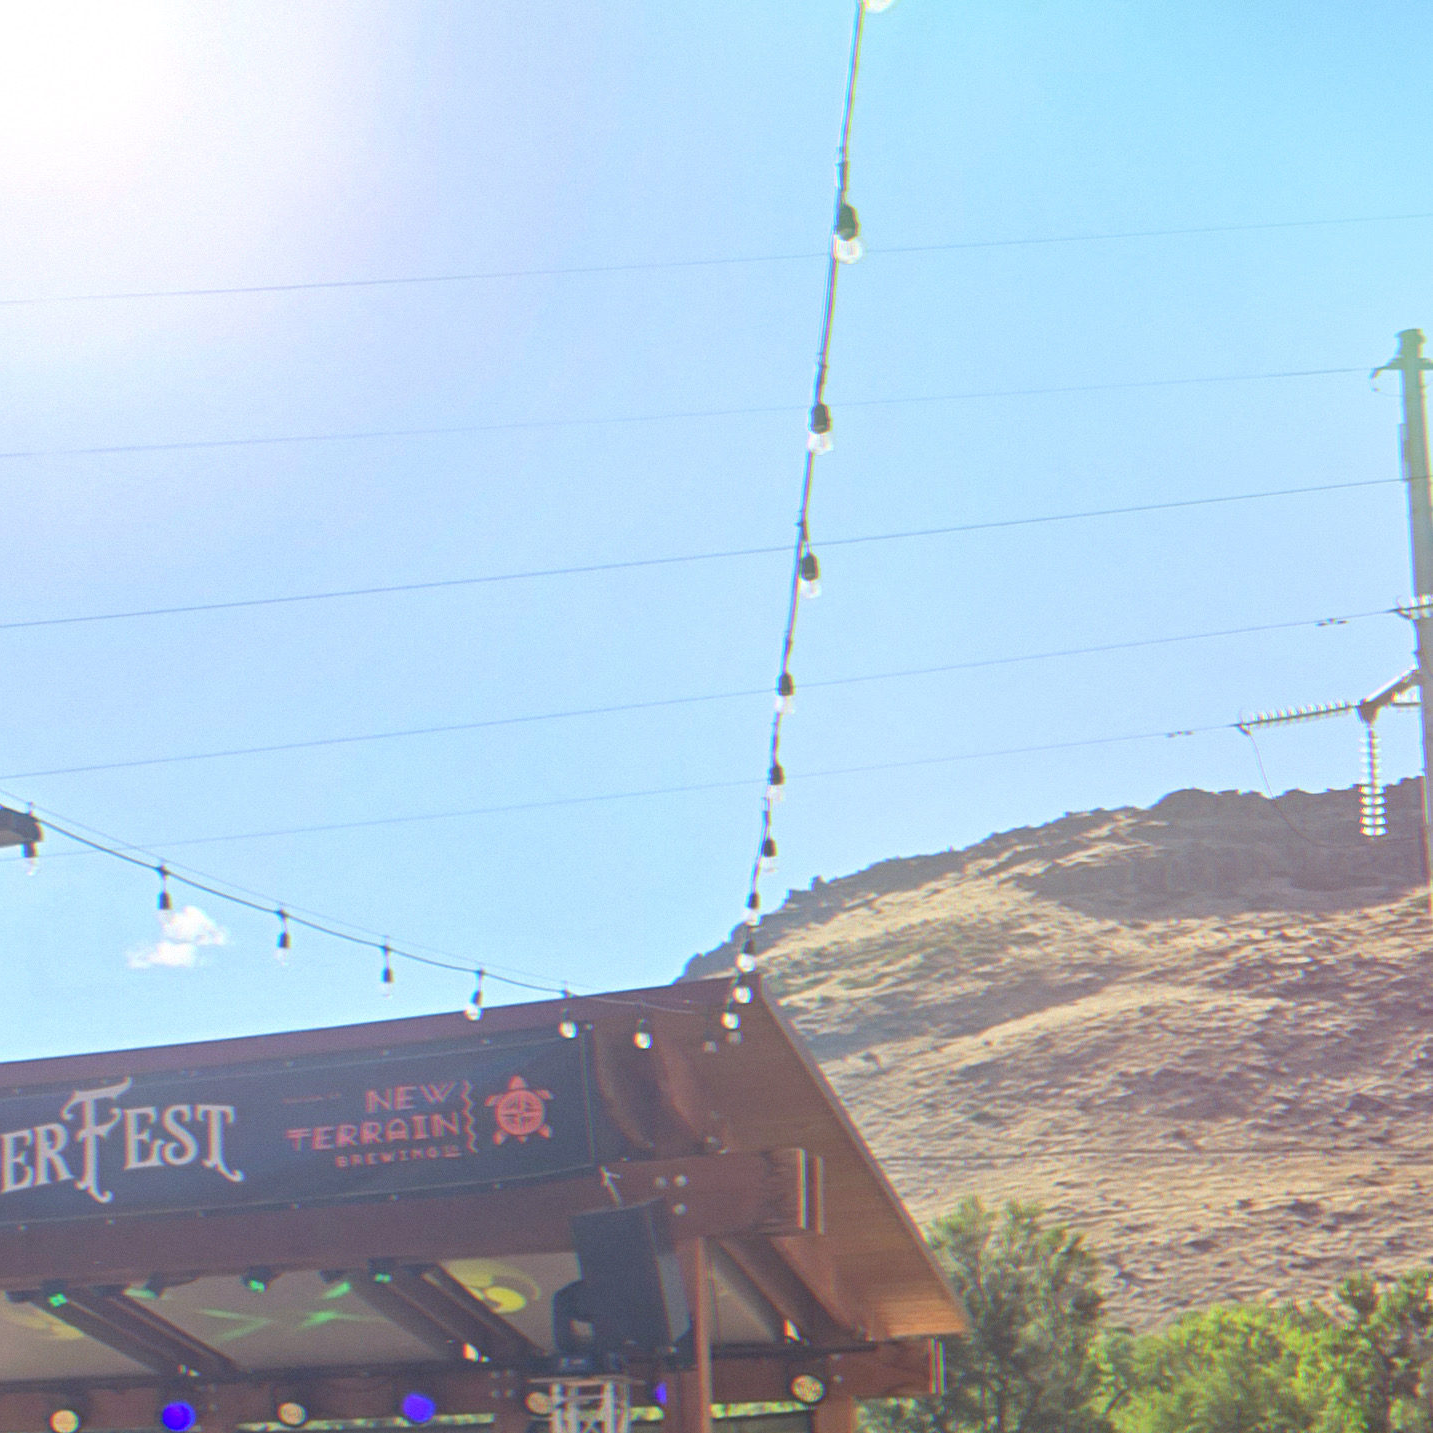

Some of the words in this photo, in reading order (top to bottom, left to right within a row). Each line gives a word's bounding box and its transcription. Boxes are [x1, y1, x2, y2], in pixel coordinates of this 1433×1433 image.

[367, 1080, 460, 1115] NEW
[286, 1110, 463, 1151] TERRAIN
[336, 1145, 442, 1169] BREWING
